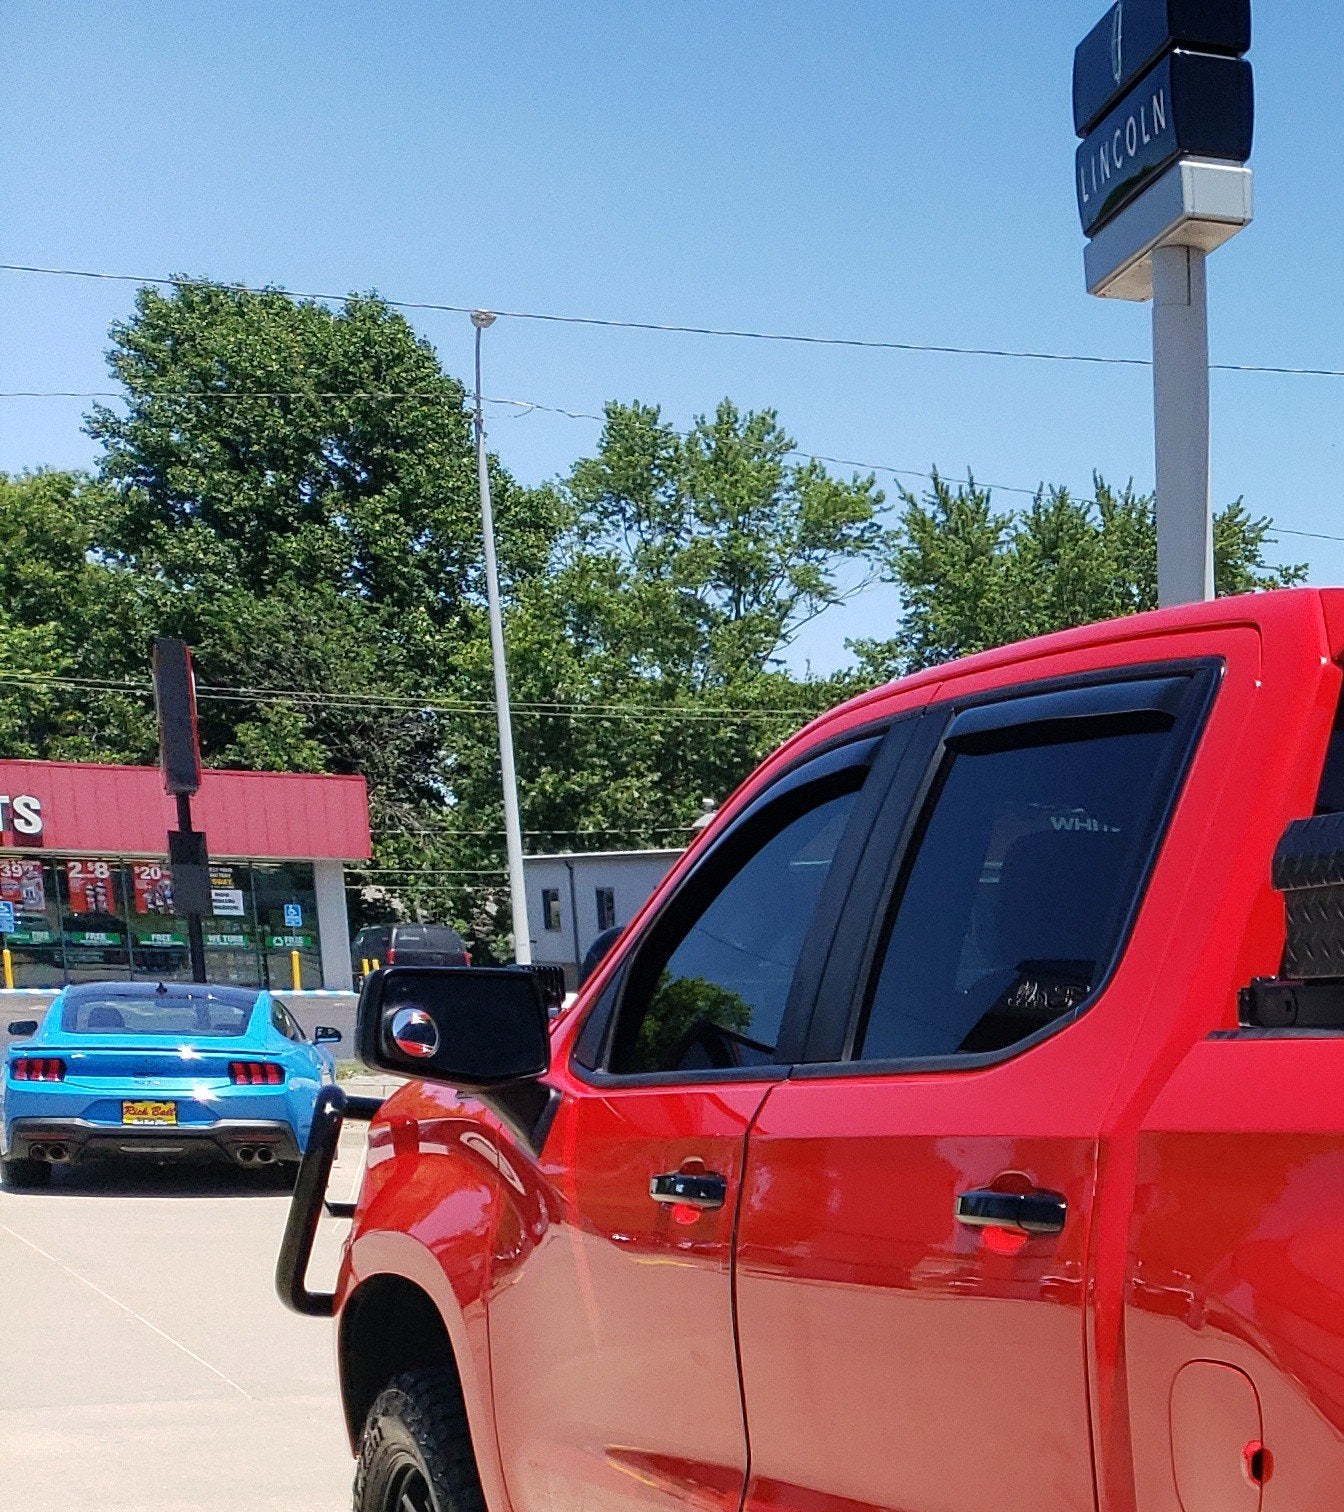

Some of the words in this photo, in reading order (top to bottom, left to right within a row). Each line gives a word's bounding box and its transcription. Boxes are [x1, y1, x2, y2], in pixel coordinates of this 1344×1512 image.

[1080, 88, 1167, 203] LINCOLN
[68, 862, 82, 878] 2
[134, 865, 162, 880] $20
